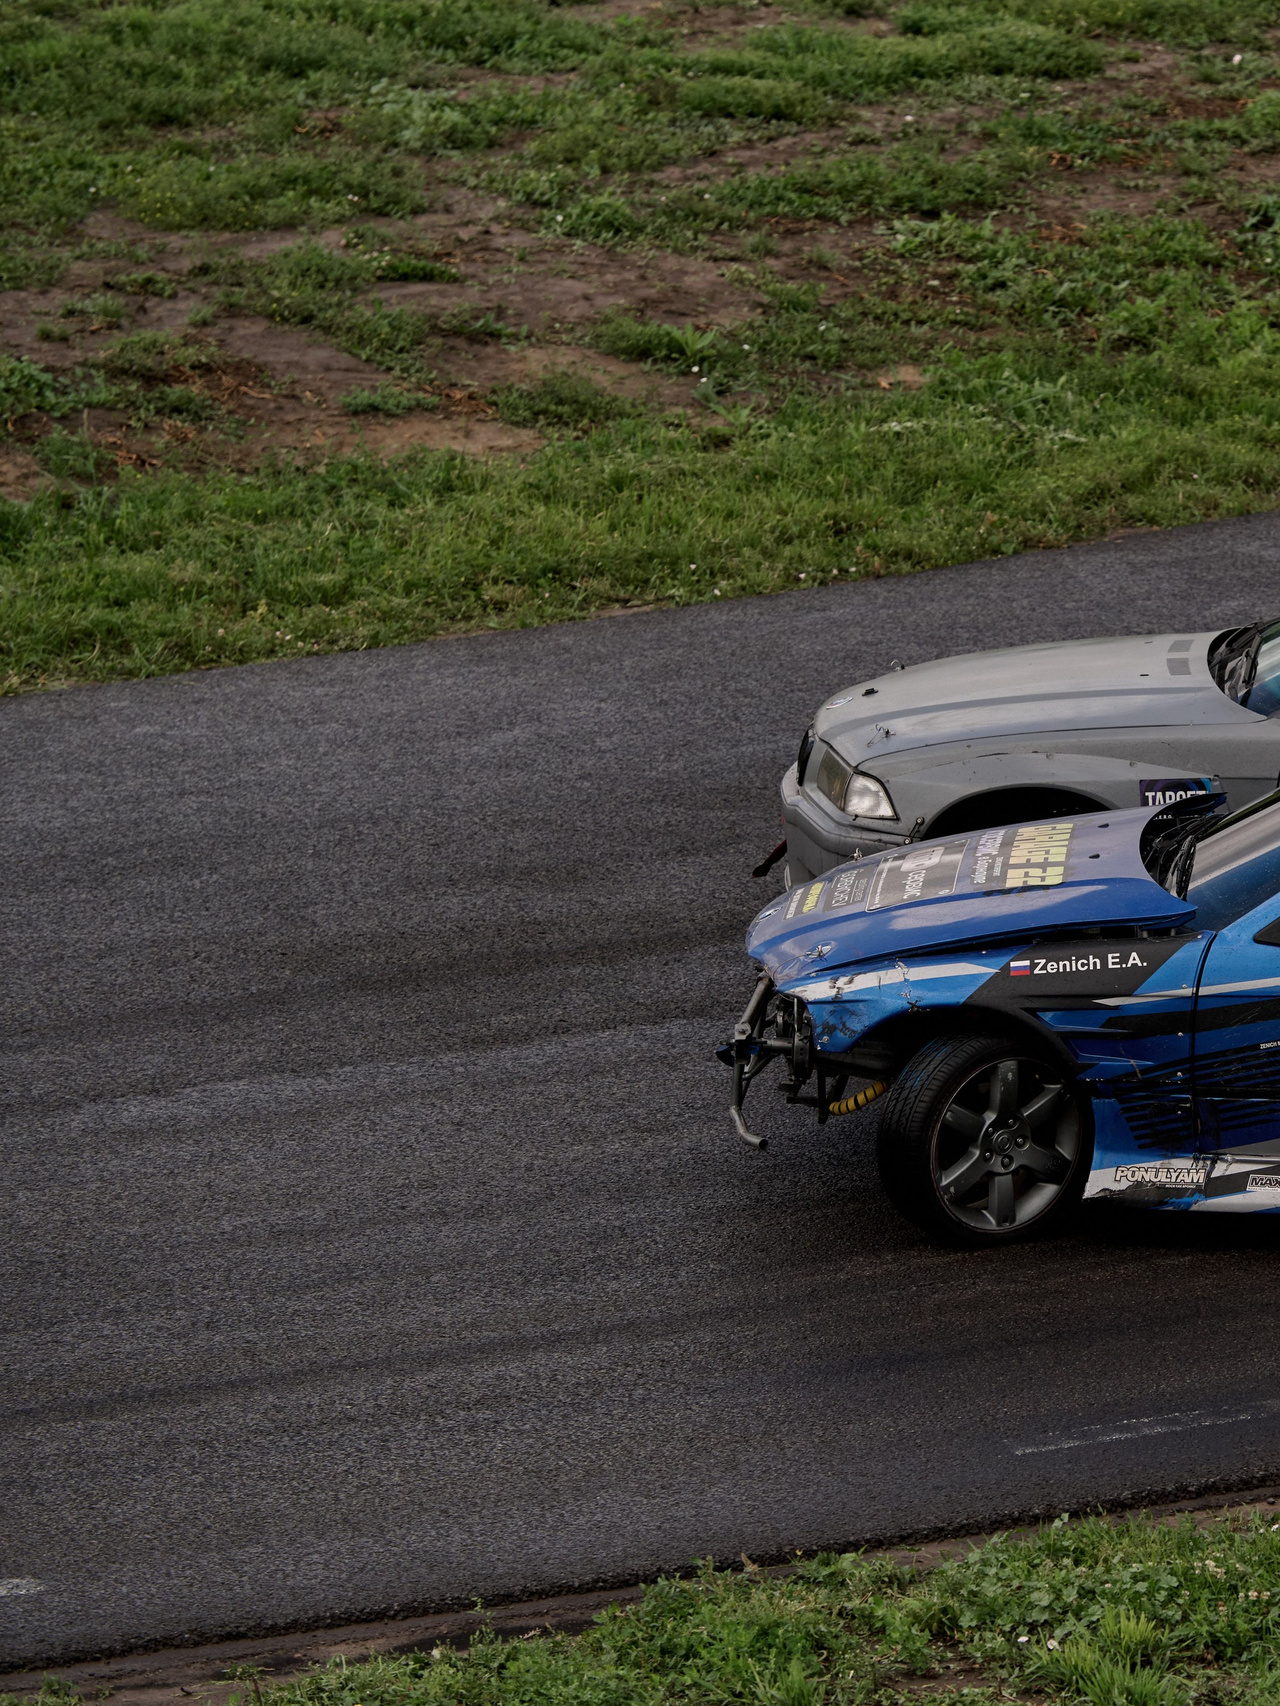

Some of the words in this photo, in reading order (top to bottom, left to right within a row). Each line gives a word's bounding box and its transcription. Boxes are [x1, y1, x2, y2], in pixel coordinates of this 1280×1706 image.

[1009, 823, 1073, 865] GARAGE
[1005, 866, 1064, 888] 22
[1033, 955, 1101, 974] Zenich
[1107, 952, 1147, 969] E.A.
[1114, 1166, 1206, 1183] PONULYAM
